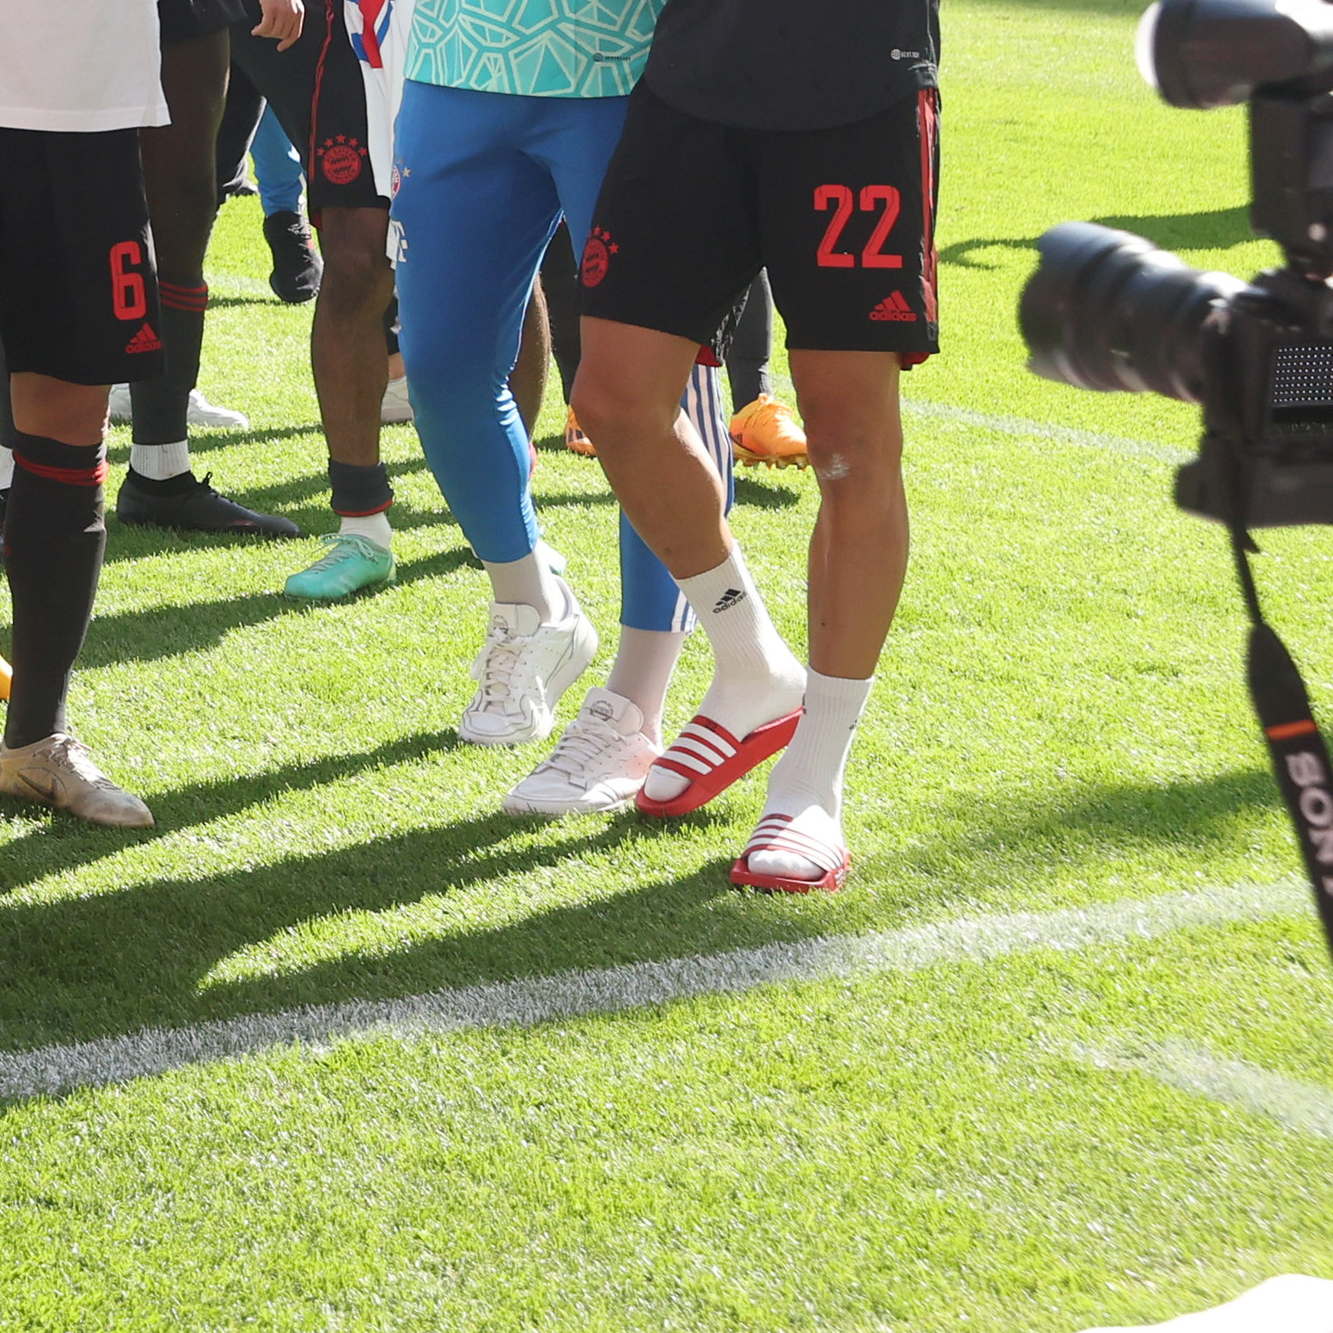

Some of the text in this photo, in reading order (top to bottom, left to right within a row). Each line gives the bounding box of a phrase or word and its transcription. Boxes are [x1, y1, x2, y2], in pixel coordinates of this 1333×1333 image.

[813, 184, 903, 269] 22
[109, 240, 147, 321] 6
[869, 310, 917, 321] adidas
